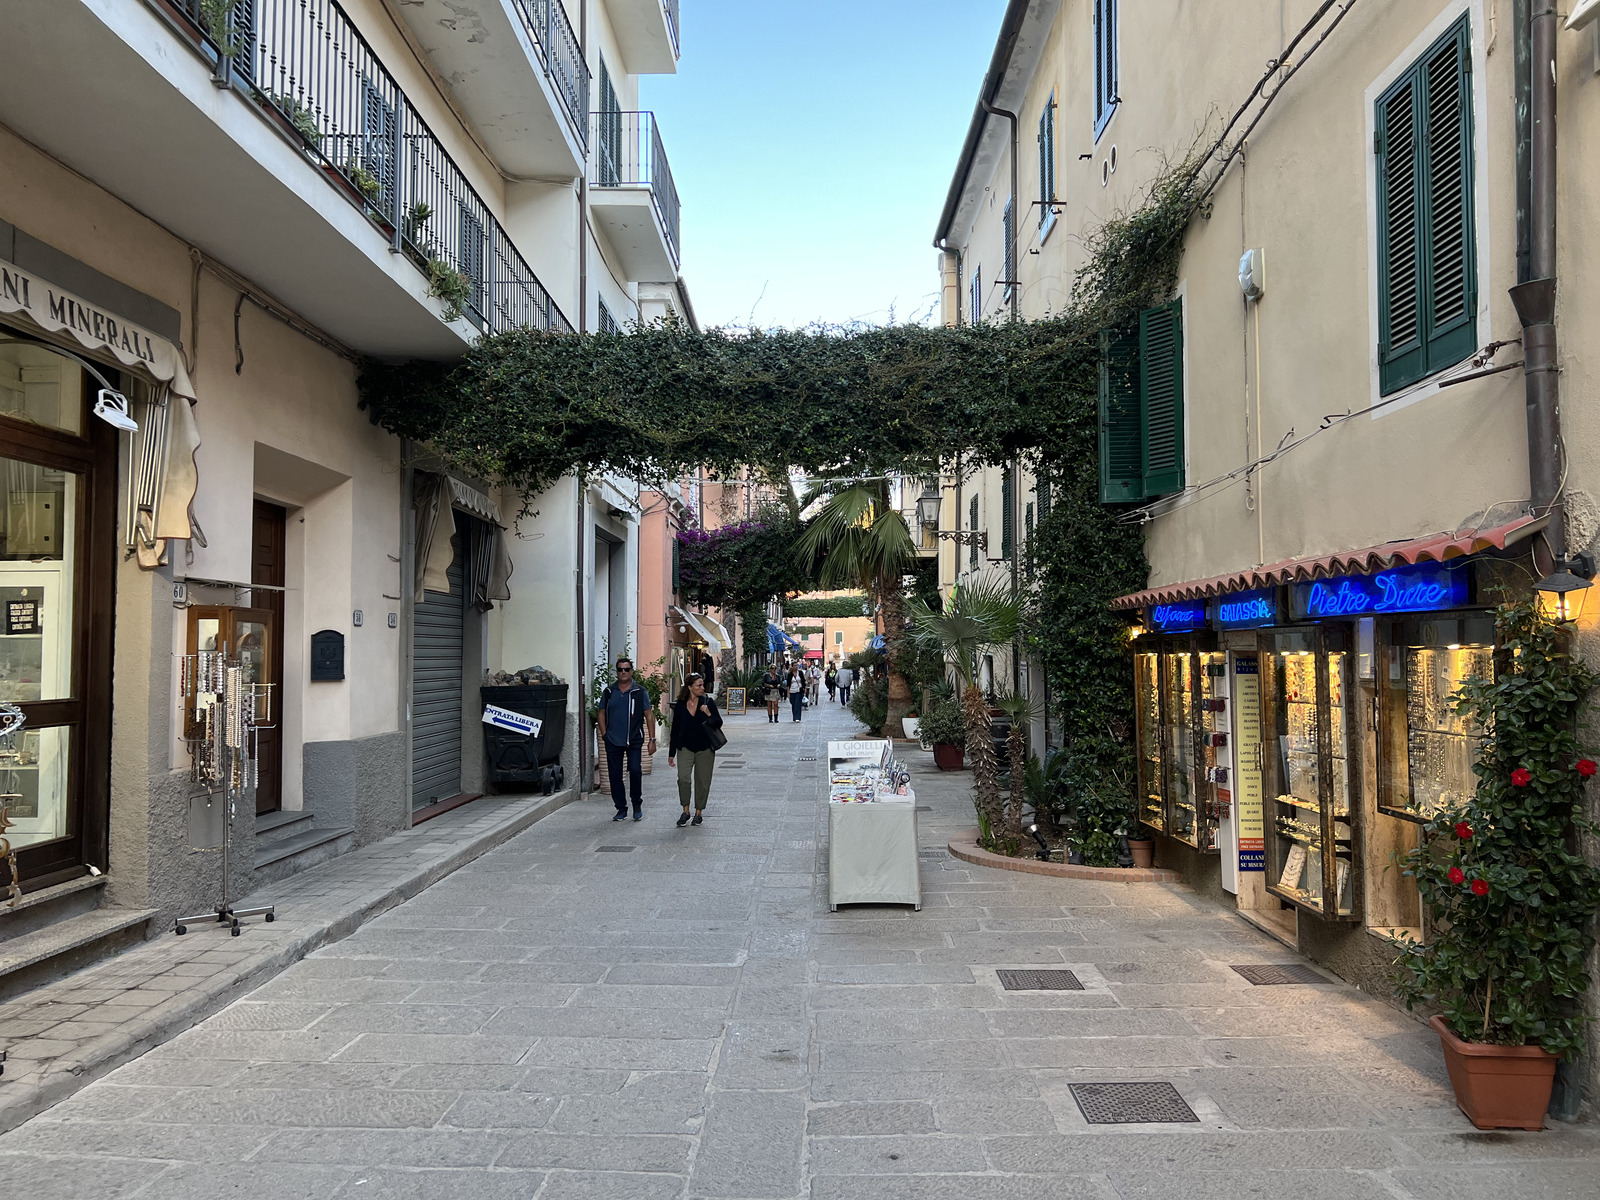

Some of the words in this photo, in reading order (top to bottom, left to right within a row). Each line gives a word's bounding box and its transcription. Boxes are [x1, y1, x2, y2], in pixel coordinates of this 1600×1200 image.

[0, 267, 32, 309] NI
[48, 289, 156, 364] MINERALI
[173, 585, 184, 598] 60
[1306, 581, 1370, 614] Pietre
[1374, 574, 1447, 610] Dure
[485, 707, 515, 721] ENTRATA
[514, 717, 540, 729] LIBERA
[843, 742, 883, 750] GIOIELLI
